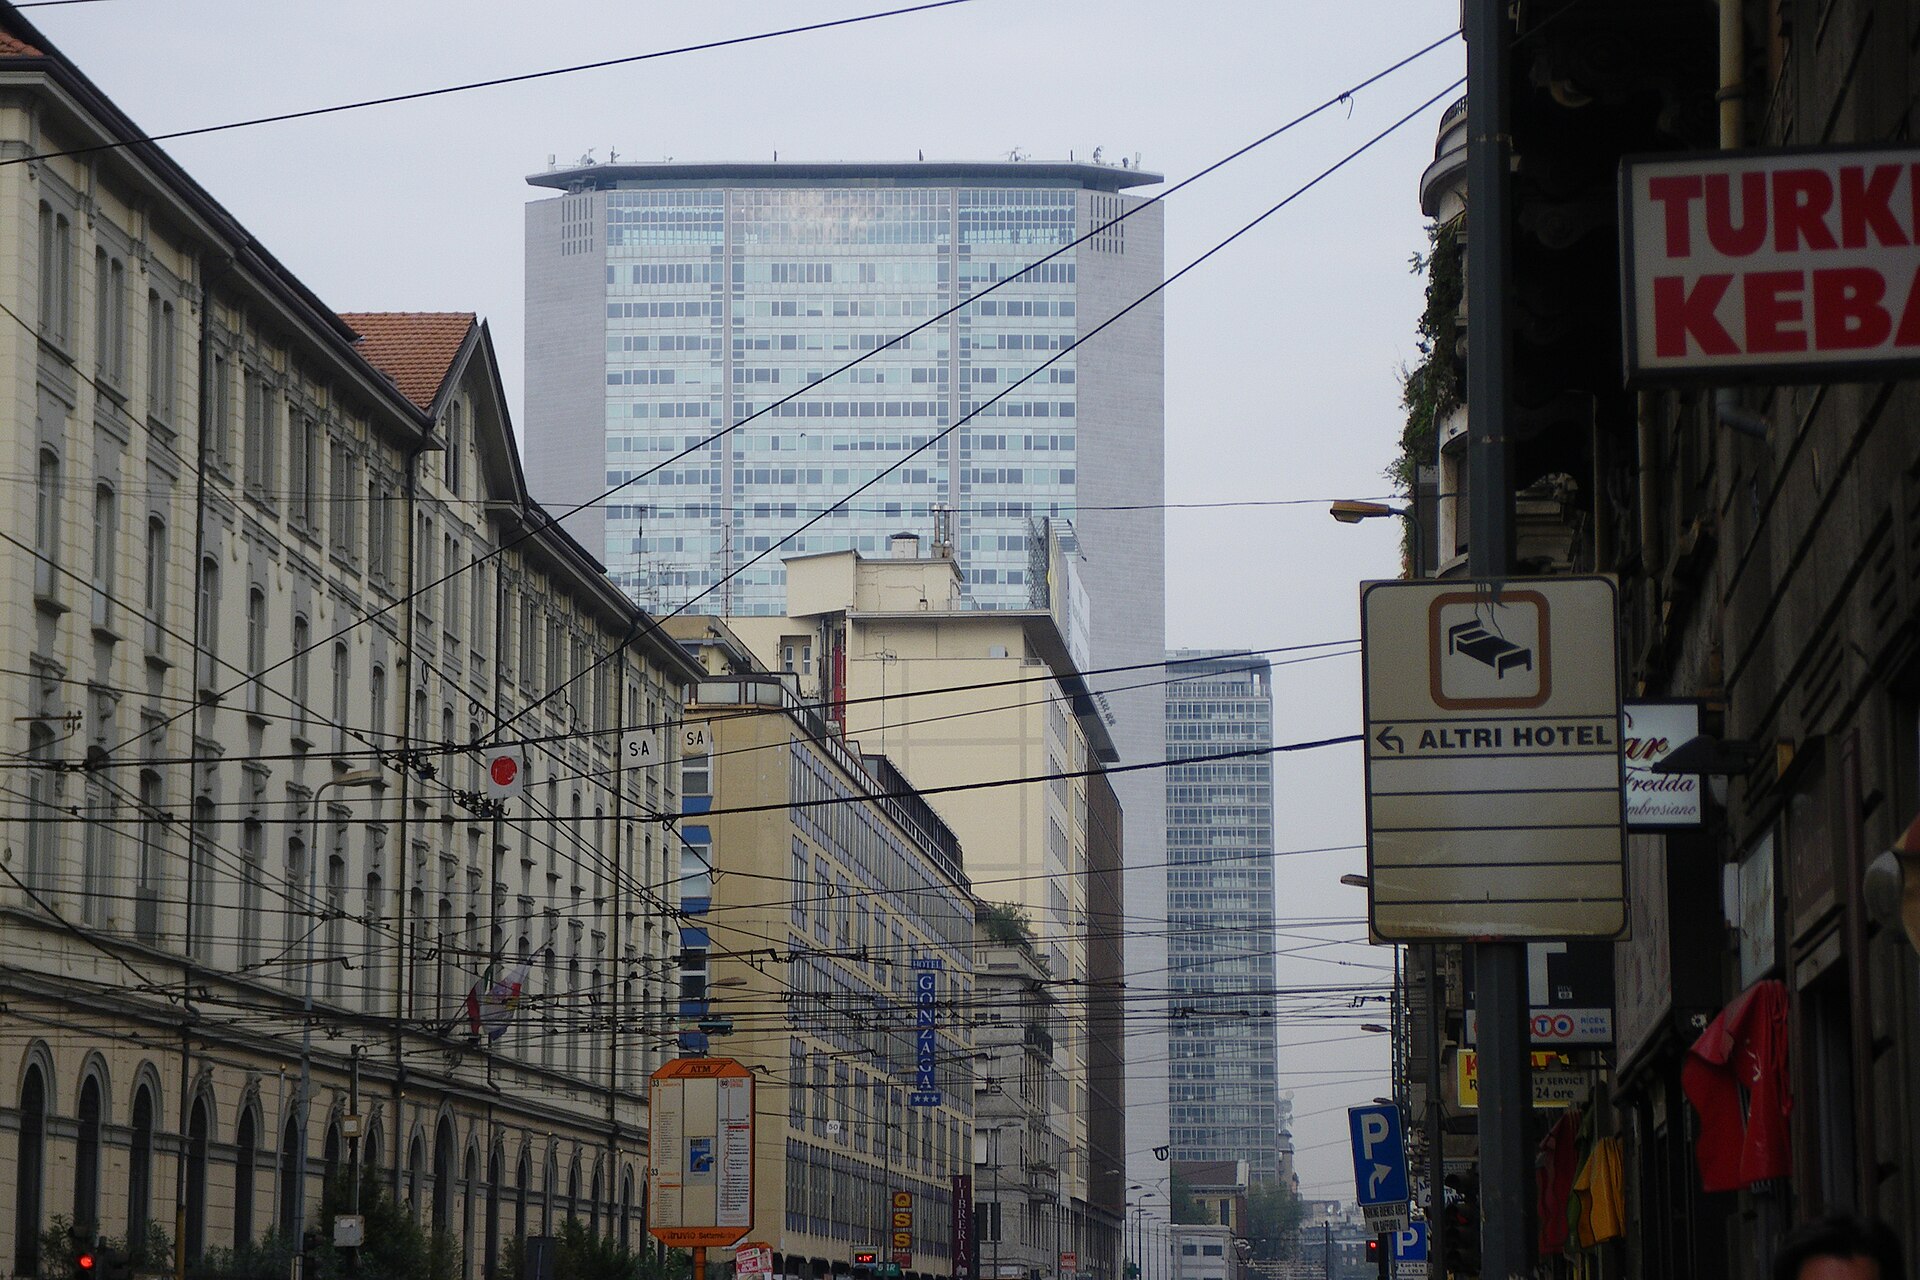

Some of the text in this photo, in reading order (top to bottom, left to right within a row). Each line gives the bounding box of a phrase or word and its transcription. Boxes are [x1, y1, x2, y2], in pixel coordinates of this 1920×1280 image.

[1418, 724, 1612, 750] ALTRI HOTEL
[1627, 798, 1697, 817] mbrosiano
[913, 960, 941, 969] HOTEL
[919, 975, 934, 1089] GONZAGA
[691, 1065, 711, 1074] ATM
[651, 1079, 660, 1088] 33
[1547, 1077, 1585, 1085] SERVICE
[1536, 1087, 1575, 1099] 24 ore
[1361, 1113, 1390, 1161] P
[651, 1168, 659, 1176] 33
[958, 1178, 967, 1261] LIBRERIA
[1397, 1227, 1419, 1256] P
